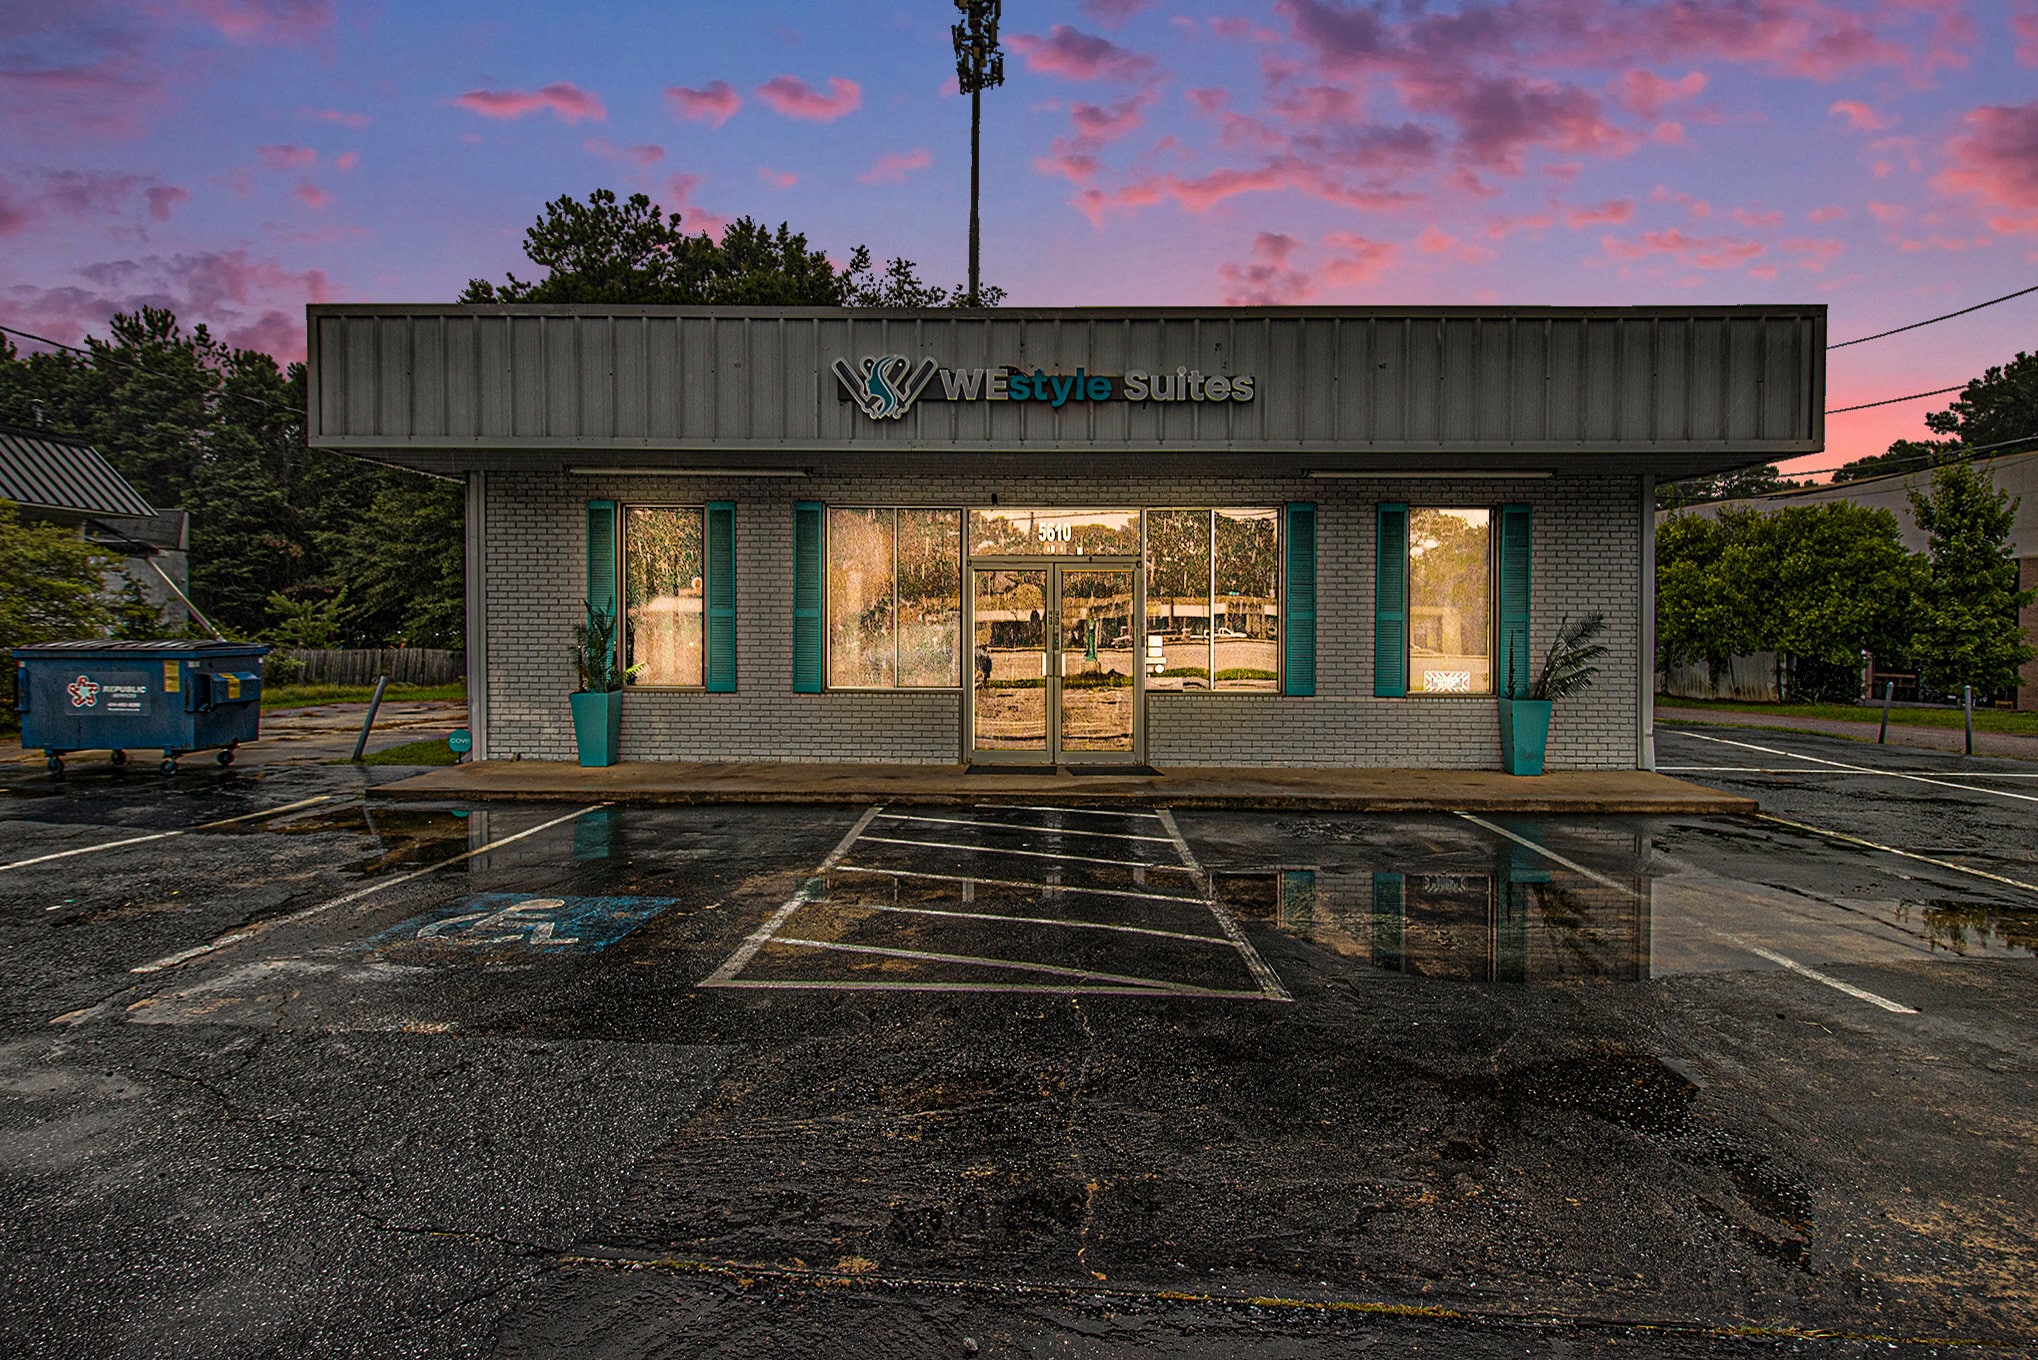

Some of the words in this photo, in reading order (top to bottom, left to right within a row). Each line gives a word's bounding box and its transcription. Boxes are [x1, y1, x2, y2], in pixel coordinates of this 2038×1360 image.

[939, 367, 1113, 409] WEstyle
[1123, 365, 1255, 402] Suites
[1038, 521, 1072, 543] 5610
[101, 685, 147, 694] REPUBLIC
